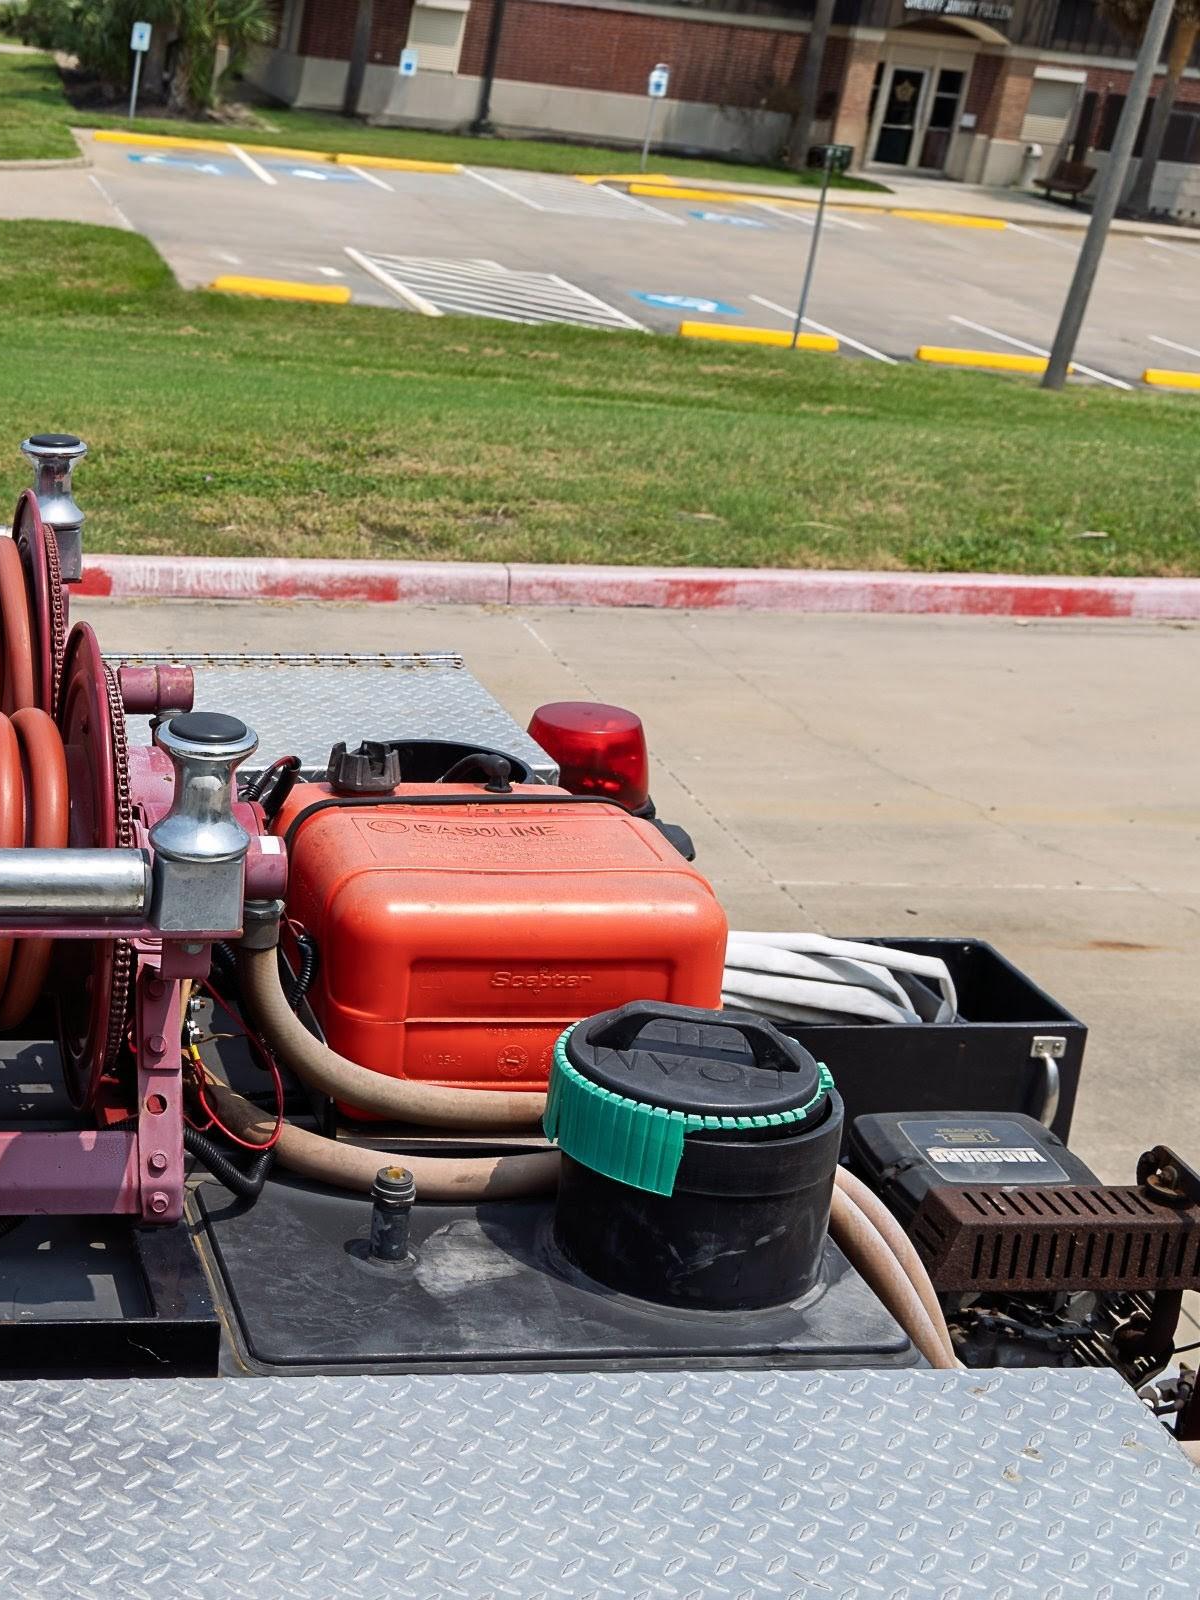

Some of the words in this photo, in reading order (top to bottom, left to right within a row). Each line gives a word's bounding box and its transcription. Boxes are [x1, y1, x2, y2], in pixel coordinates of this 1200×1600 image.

[413, 823, 561, 838] GASOLINE
[490, 970, 593, 993] Scepter
[926, 1147, 1048, 1163] VANGUARD
